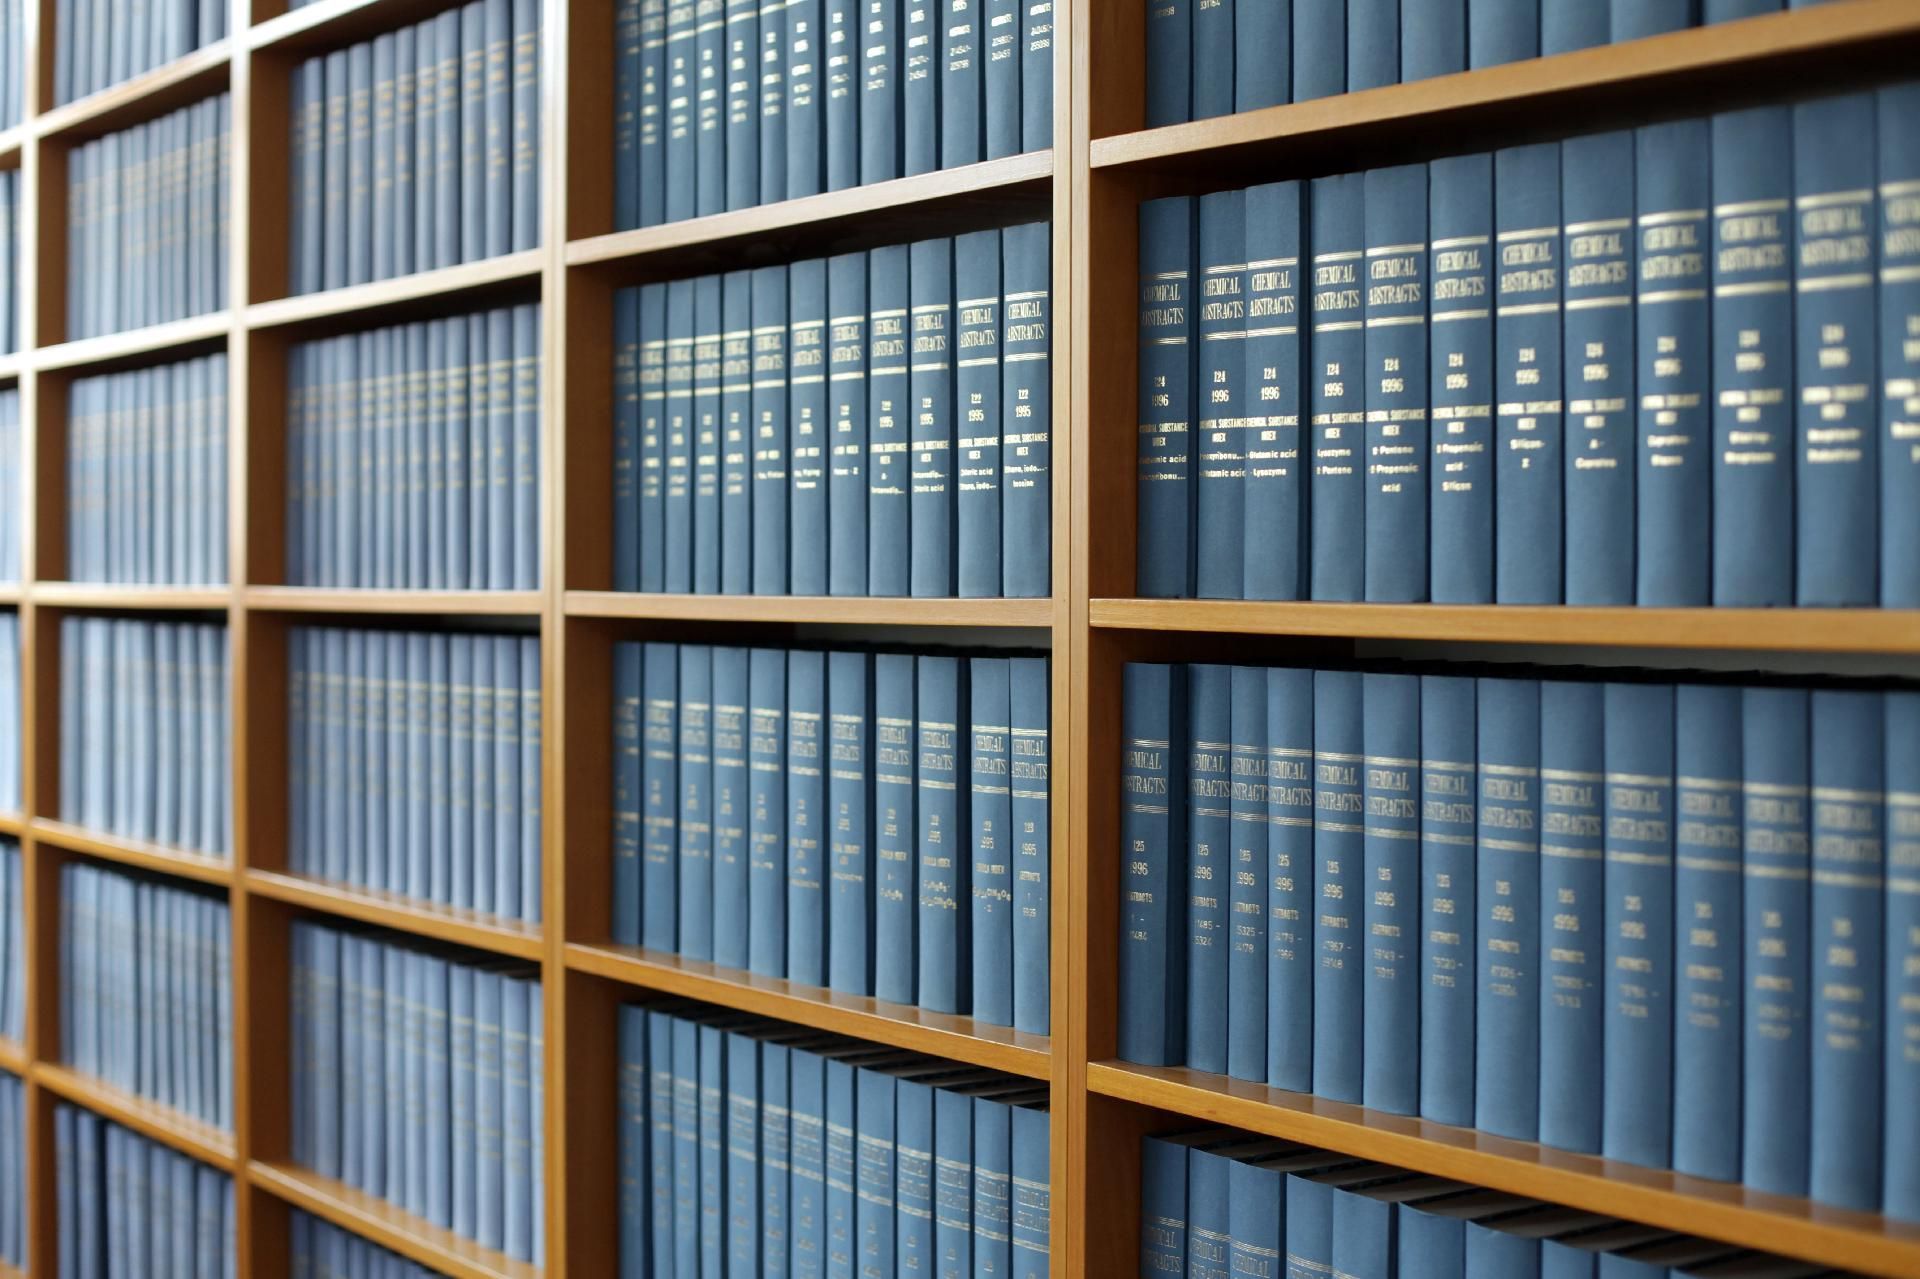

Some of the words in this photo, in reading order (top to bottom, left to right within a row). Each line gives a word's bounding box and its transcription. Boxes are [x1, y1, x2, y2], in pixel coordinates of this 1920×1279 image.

[1314, 265, 1356, 286] CHEMICAL
[1370, 257, 1417, 280] CHEMICAL
[1203, 277, 1241, 297] CHEMICAL
[1251, 271, 1292, 292] CHEMICAL
[1314, 290, 1360, 312] ABSTRACTS
[1368, 284, 1421, 306] ABSTRACTS
[1008, 302, 1042, 320] CHEMICAL
[1201, 300, 1244, 321] ABSTRACTS
[1250, 296, 1295, 317] ABSTRACTS
[1006, 324, 1045, 342] ABSTRACTS
[1214, 370, 1226, 383] 124
[1264, 367, 1277, 380] 124
[1260, 387, 1280, 400] 1996
[1324, 383, 1344, 397] 1996
[1381, 378, 1404, 393] 1996
[1212, 390, 1230, 403] 1996
[1158, 422, 1189, 433] SUBSTANCE
[1169, 454, 1188, 464] acid
[1280, 448, 1298, 459] acid
[1382, 483, 1401, 493] acid
[1125, 751, 1162, 770] EMICAL
[1122, 775, 1167, 794] STRACTS
